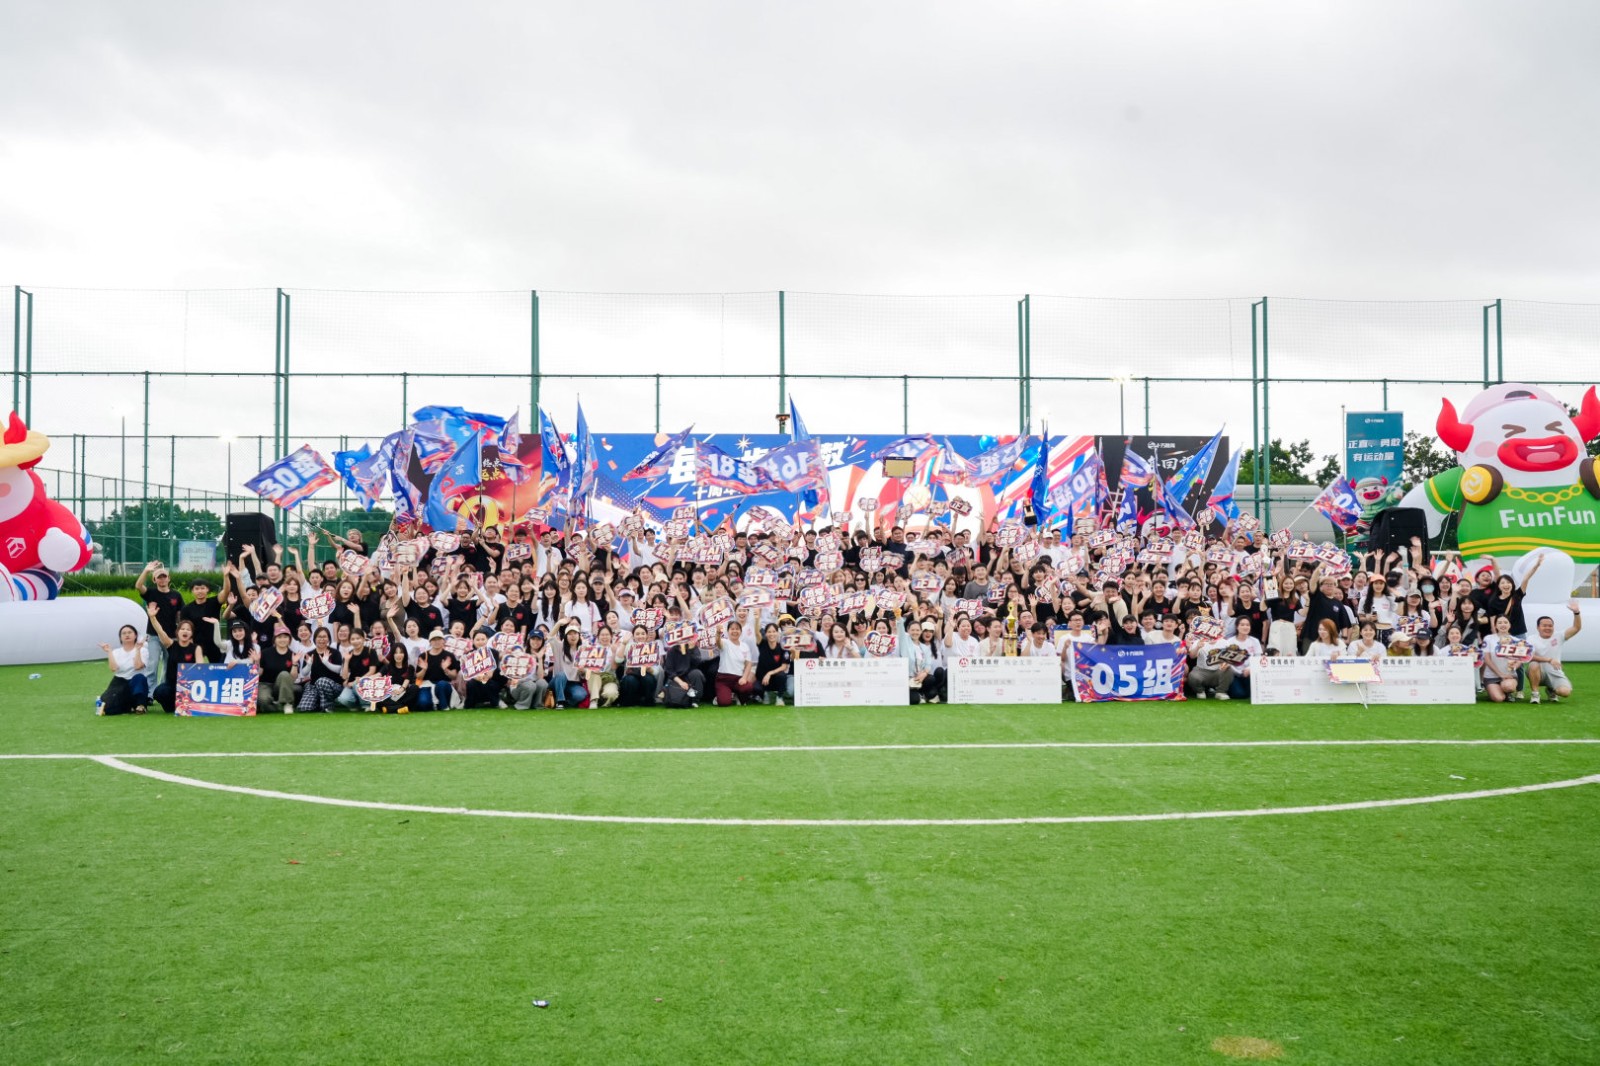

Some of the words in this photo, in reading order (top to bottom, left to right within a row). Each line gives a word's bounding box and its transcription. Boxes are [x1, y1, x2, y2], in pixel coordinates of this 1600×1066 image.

[1499, 506, 1596, 528] FunFun
[1094, 534, 1114, 544] 正直
[512, 547, 528, 557] 正直
[1151, 544, 1173, 552] 正直
[1291, 548, 1313, 557] 正直
[1320, 549, 1344, 564] 正直
[749, 575, 774, 585] 正直
[917, 579, 940, 588] 正直
[306, 595, 328, 606] 热爱
[748, 592, 769, 606] 正直
[635, 610, 657, 620] 热爱
[669, 626, 695, 641] 正直
[787, 636, 811, 648] 正直
[579, 646, 604, 658] 因AI
[631, 644, 657, 656] 因AI
[1501, 646, 1529, 656] 正直
[579, 658, 605, 668] 而不同
[631, 655, 657, 667] 而不同
[363, 679, 385, 688] 热爱
[1092, 659, 1174, 697] 05组
[191, 678, 244, 704] 01组
